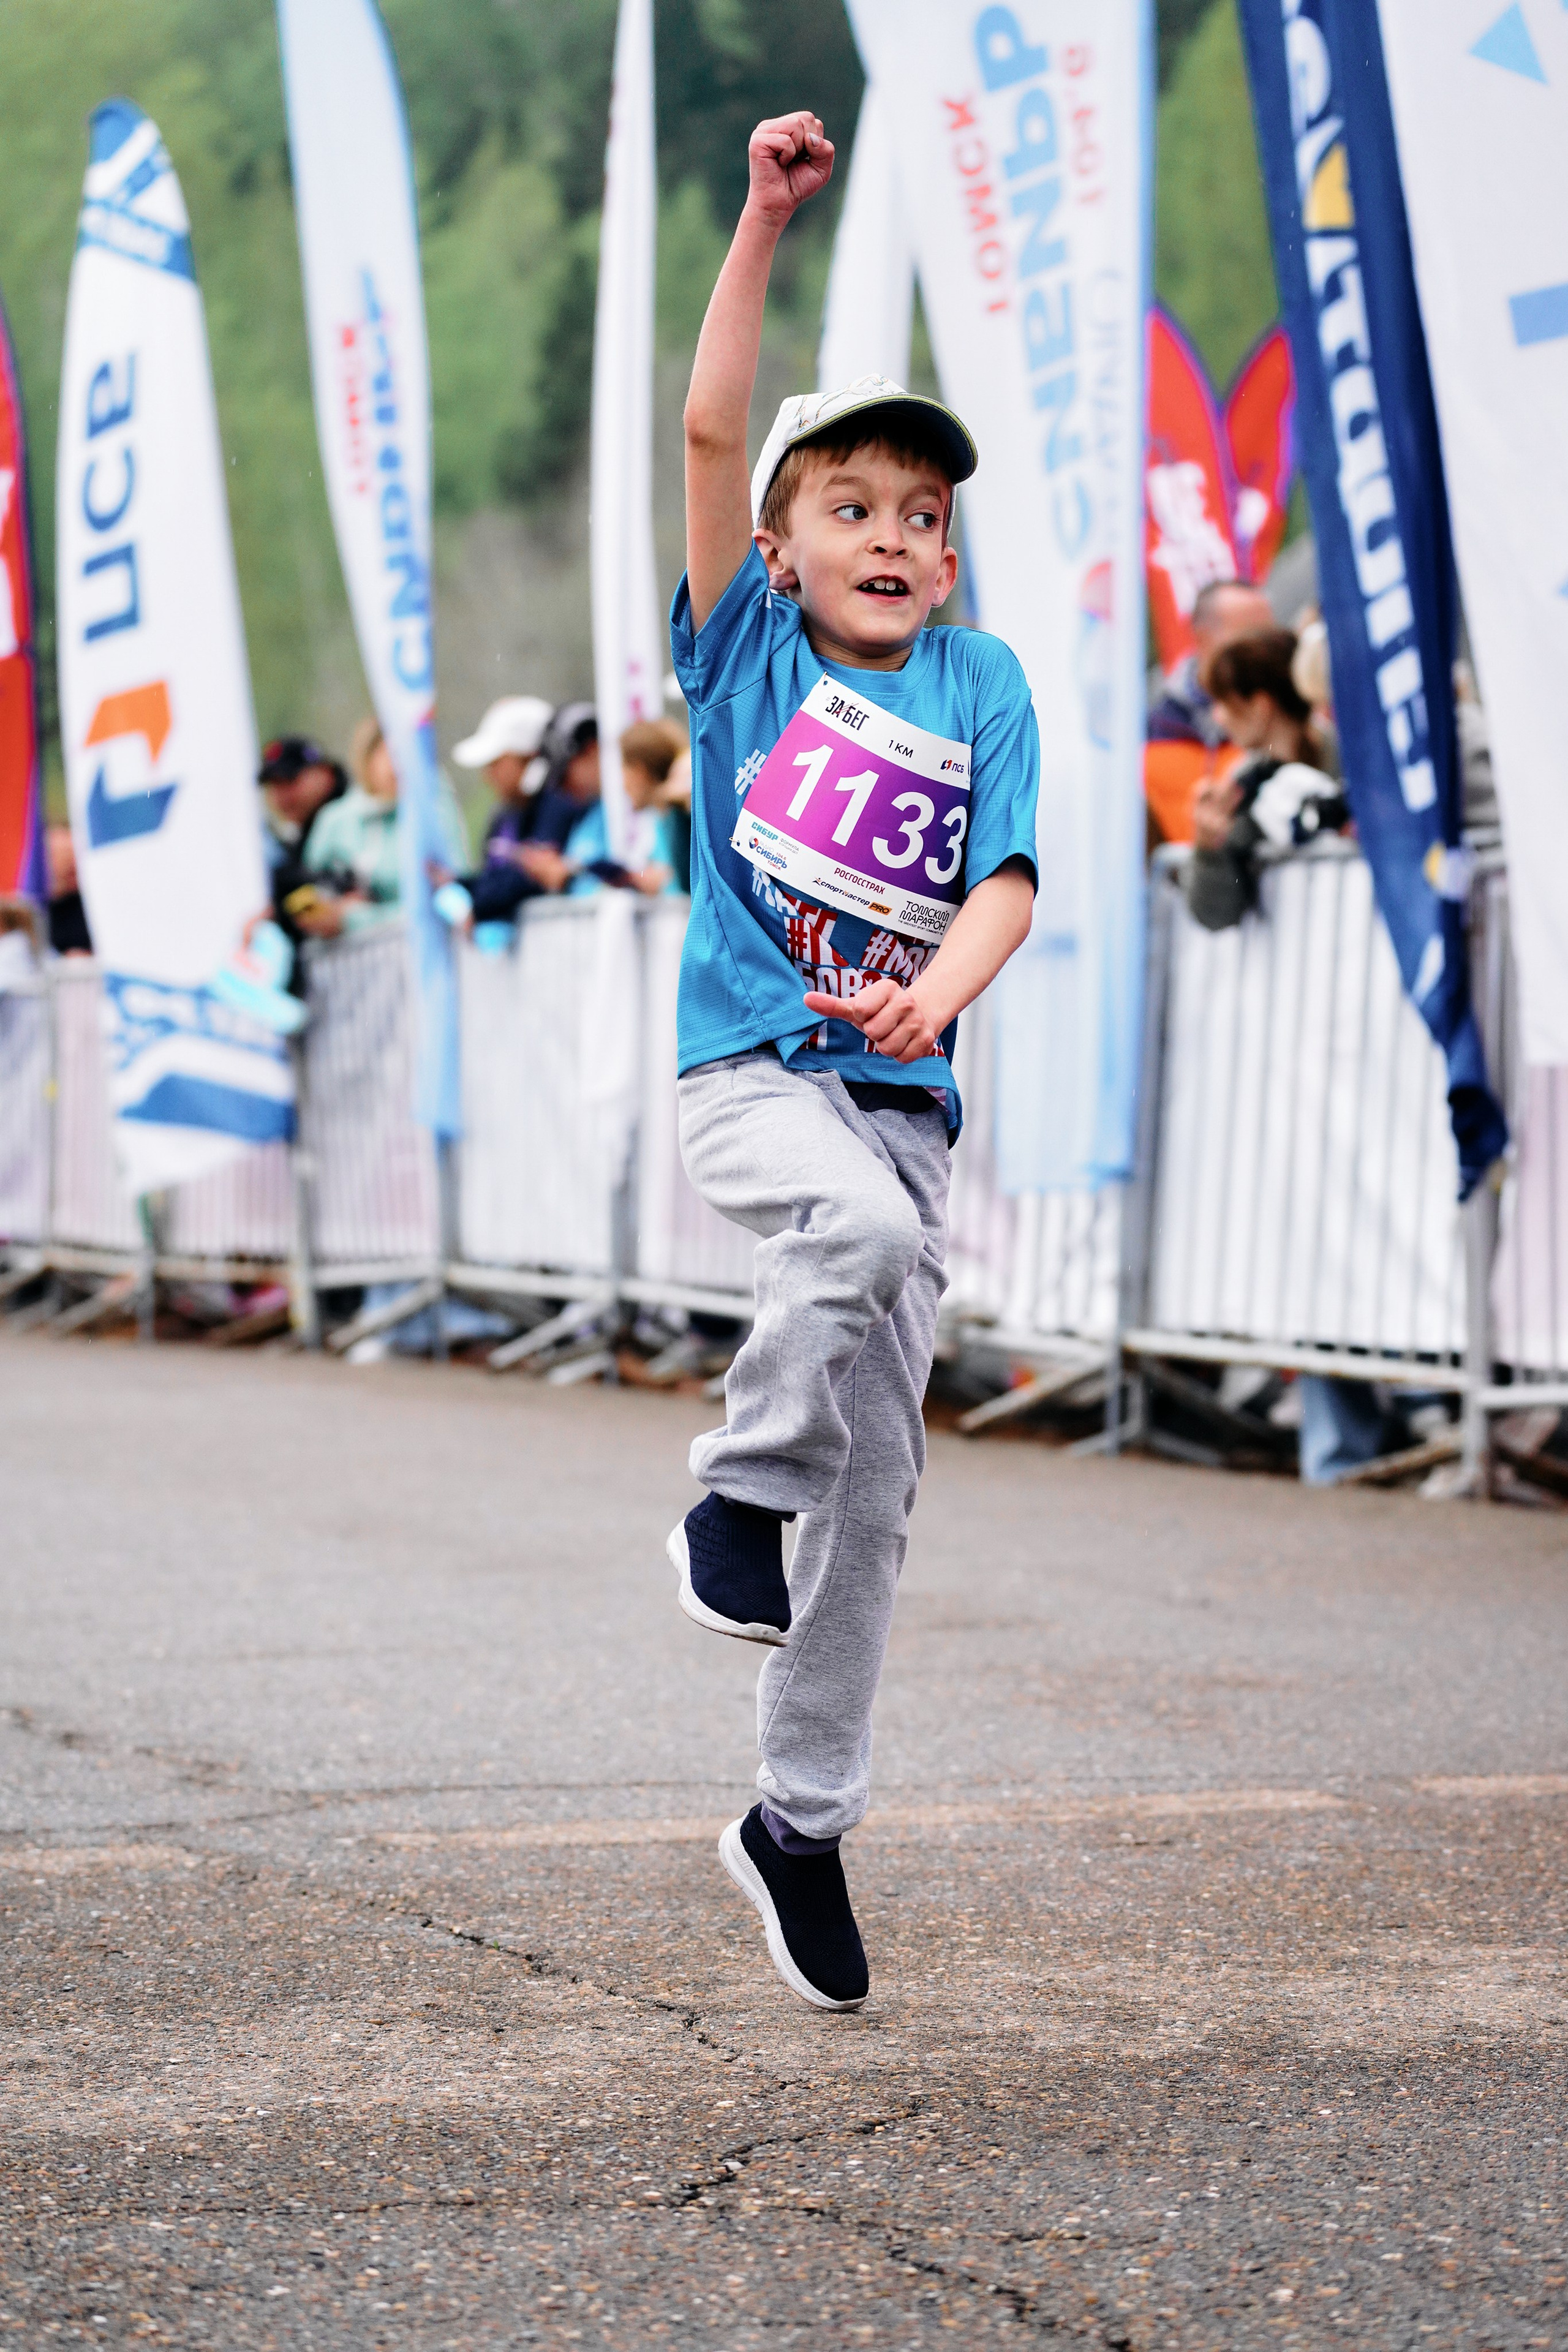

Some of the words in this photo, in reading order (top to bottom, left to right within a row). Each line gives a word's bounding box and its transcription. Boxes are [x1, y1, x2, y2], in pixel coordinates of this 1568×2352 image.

[951, 763, 965, 774] ПСБ
[785, 744, 968, 884] 1133
[751, 821, 778, 840] СИБУР
[756, 846, 788, 869] СИБИРЬ
[767, 860, 782, 871] ТОМСК
[834, 867, 886, 895] РОСГОССТРАХ
[870, 903, 890, 914] PRO
[906, 900, 950, 922] ТОМСКИЙ
[899, 910, 947, 932] МАРАФОН
